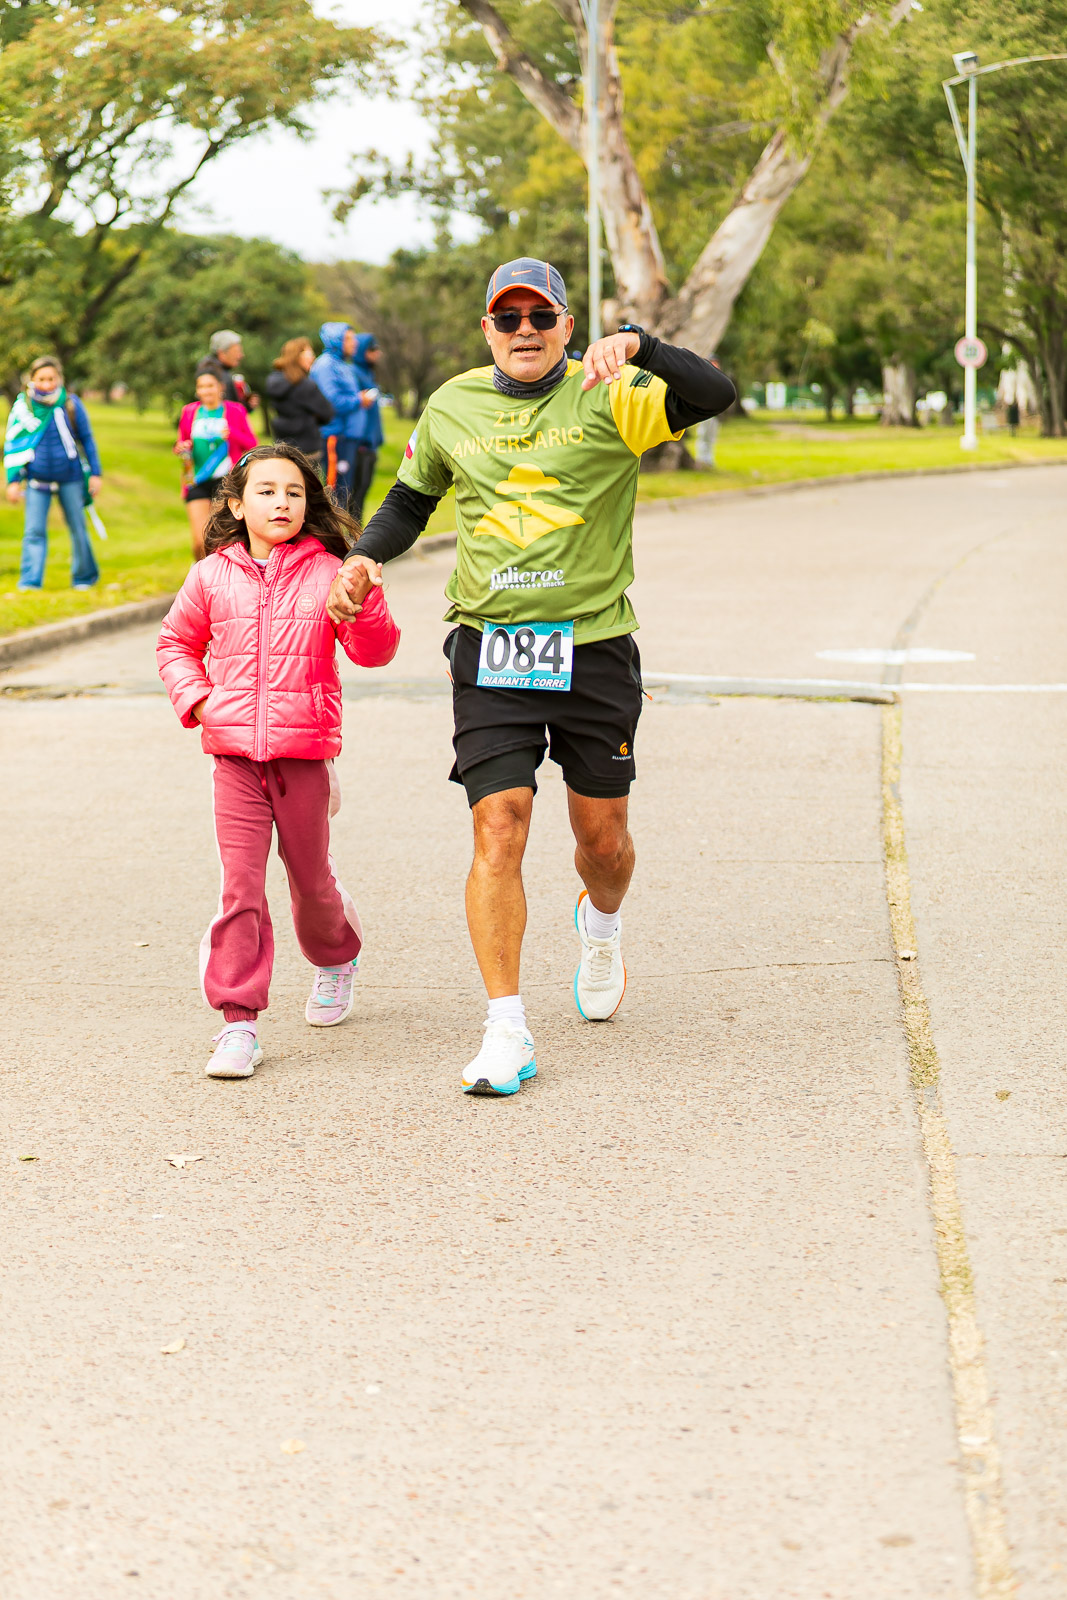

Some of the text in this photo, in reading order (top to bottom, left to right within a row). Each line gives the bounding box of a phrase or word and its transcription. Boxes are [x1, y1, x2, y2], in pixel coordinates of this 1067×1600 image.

[451, 426, 584, 459] ANIVERSARIO
[489, 566, 564, 590] julicroc
[486, 627, 565, 674] 084
[482, 676, 566, 688] DIAMANTE CORRE
